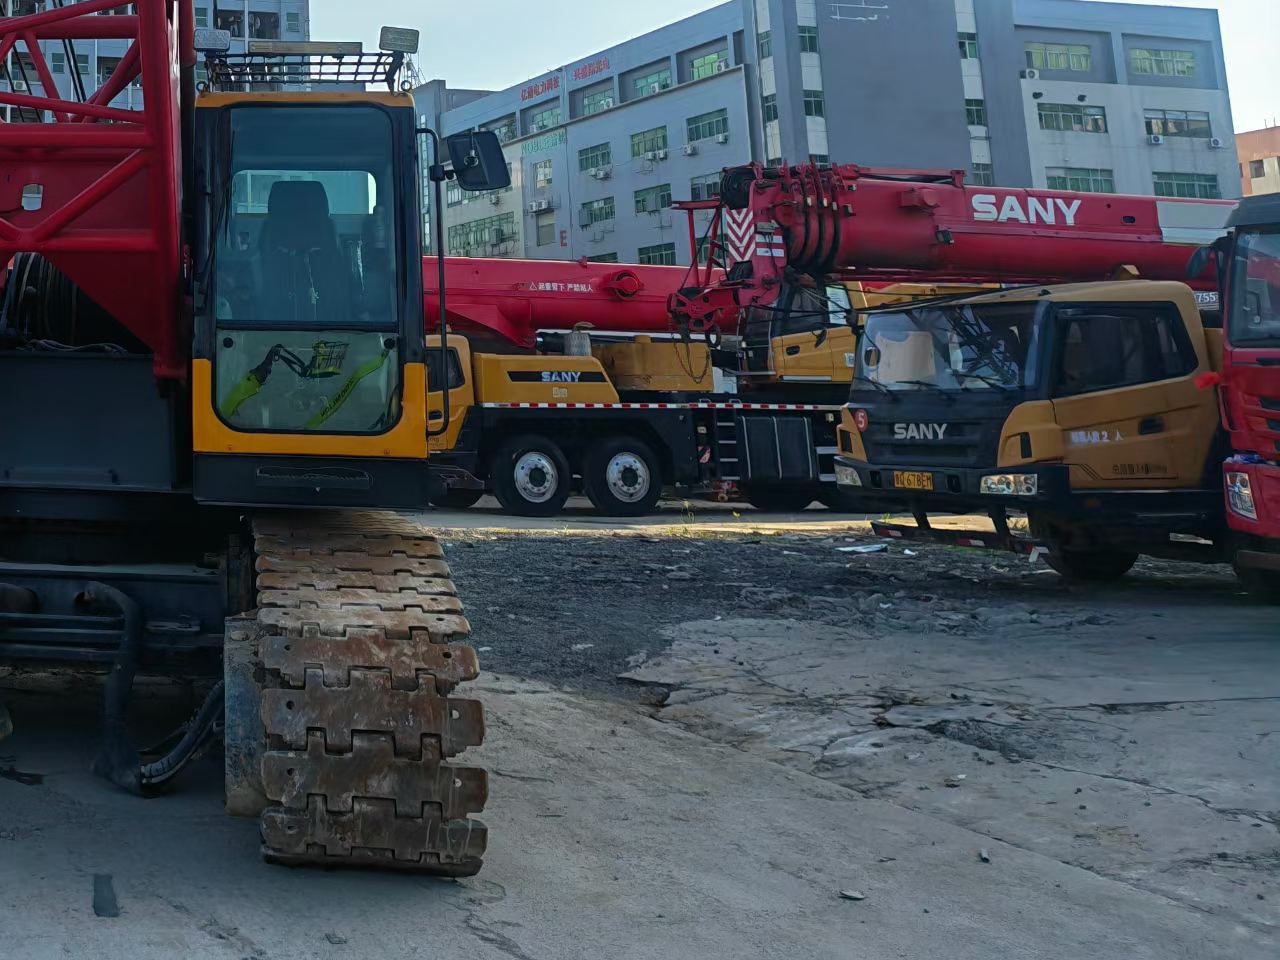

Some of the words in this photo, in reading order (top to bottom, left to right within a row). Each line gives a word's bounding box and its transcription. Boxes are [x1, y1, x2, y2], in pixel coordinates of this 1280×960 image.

[971, 194, 1082, 226] SANY
[560, 230, 568, 247] E
[541, 371, 581, 382] SANY
[858, 412, 865, 428] 5
[893, 423, 947, 440] SANY
